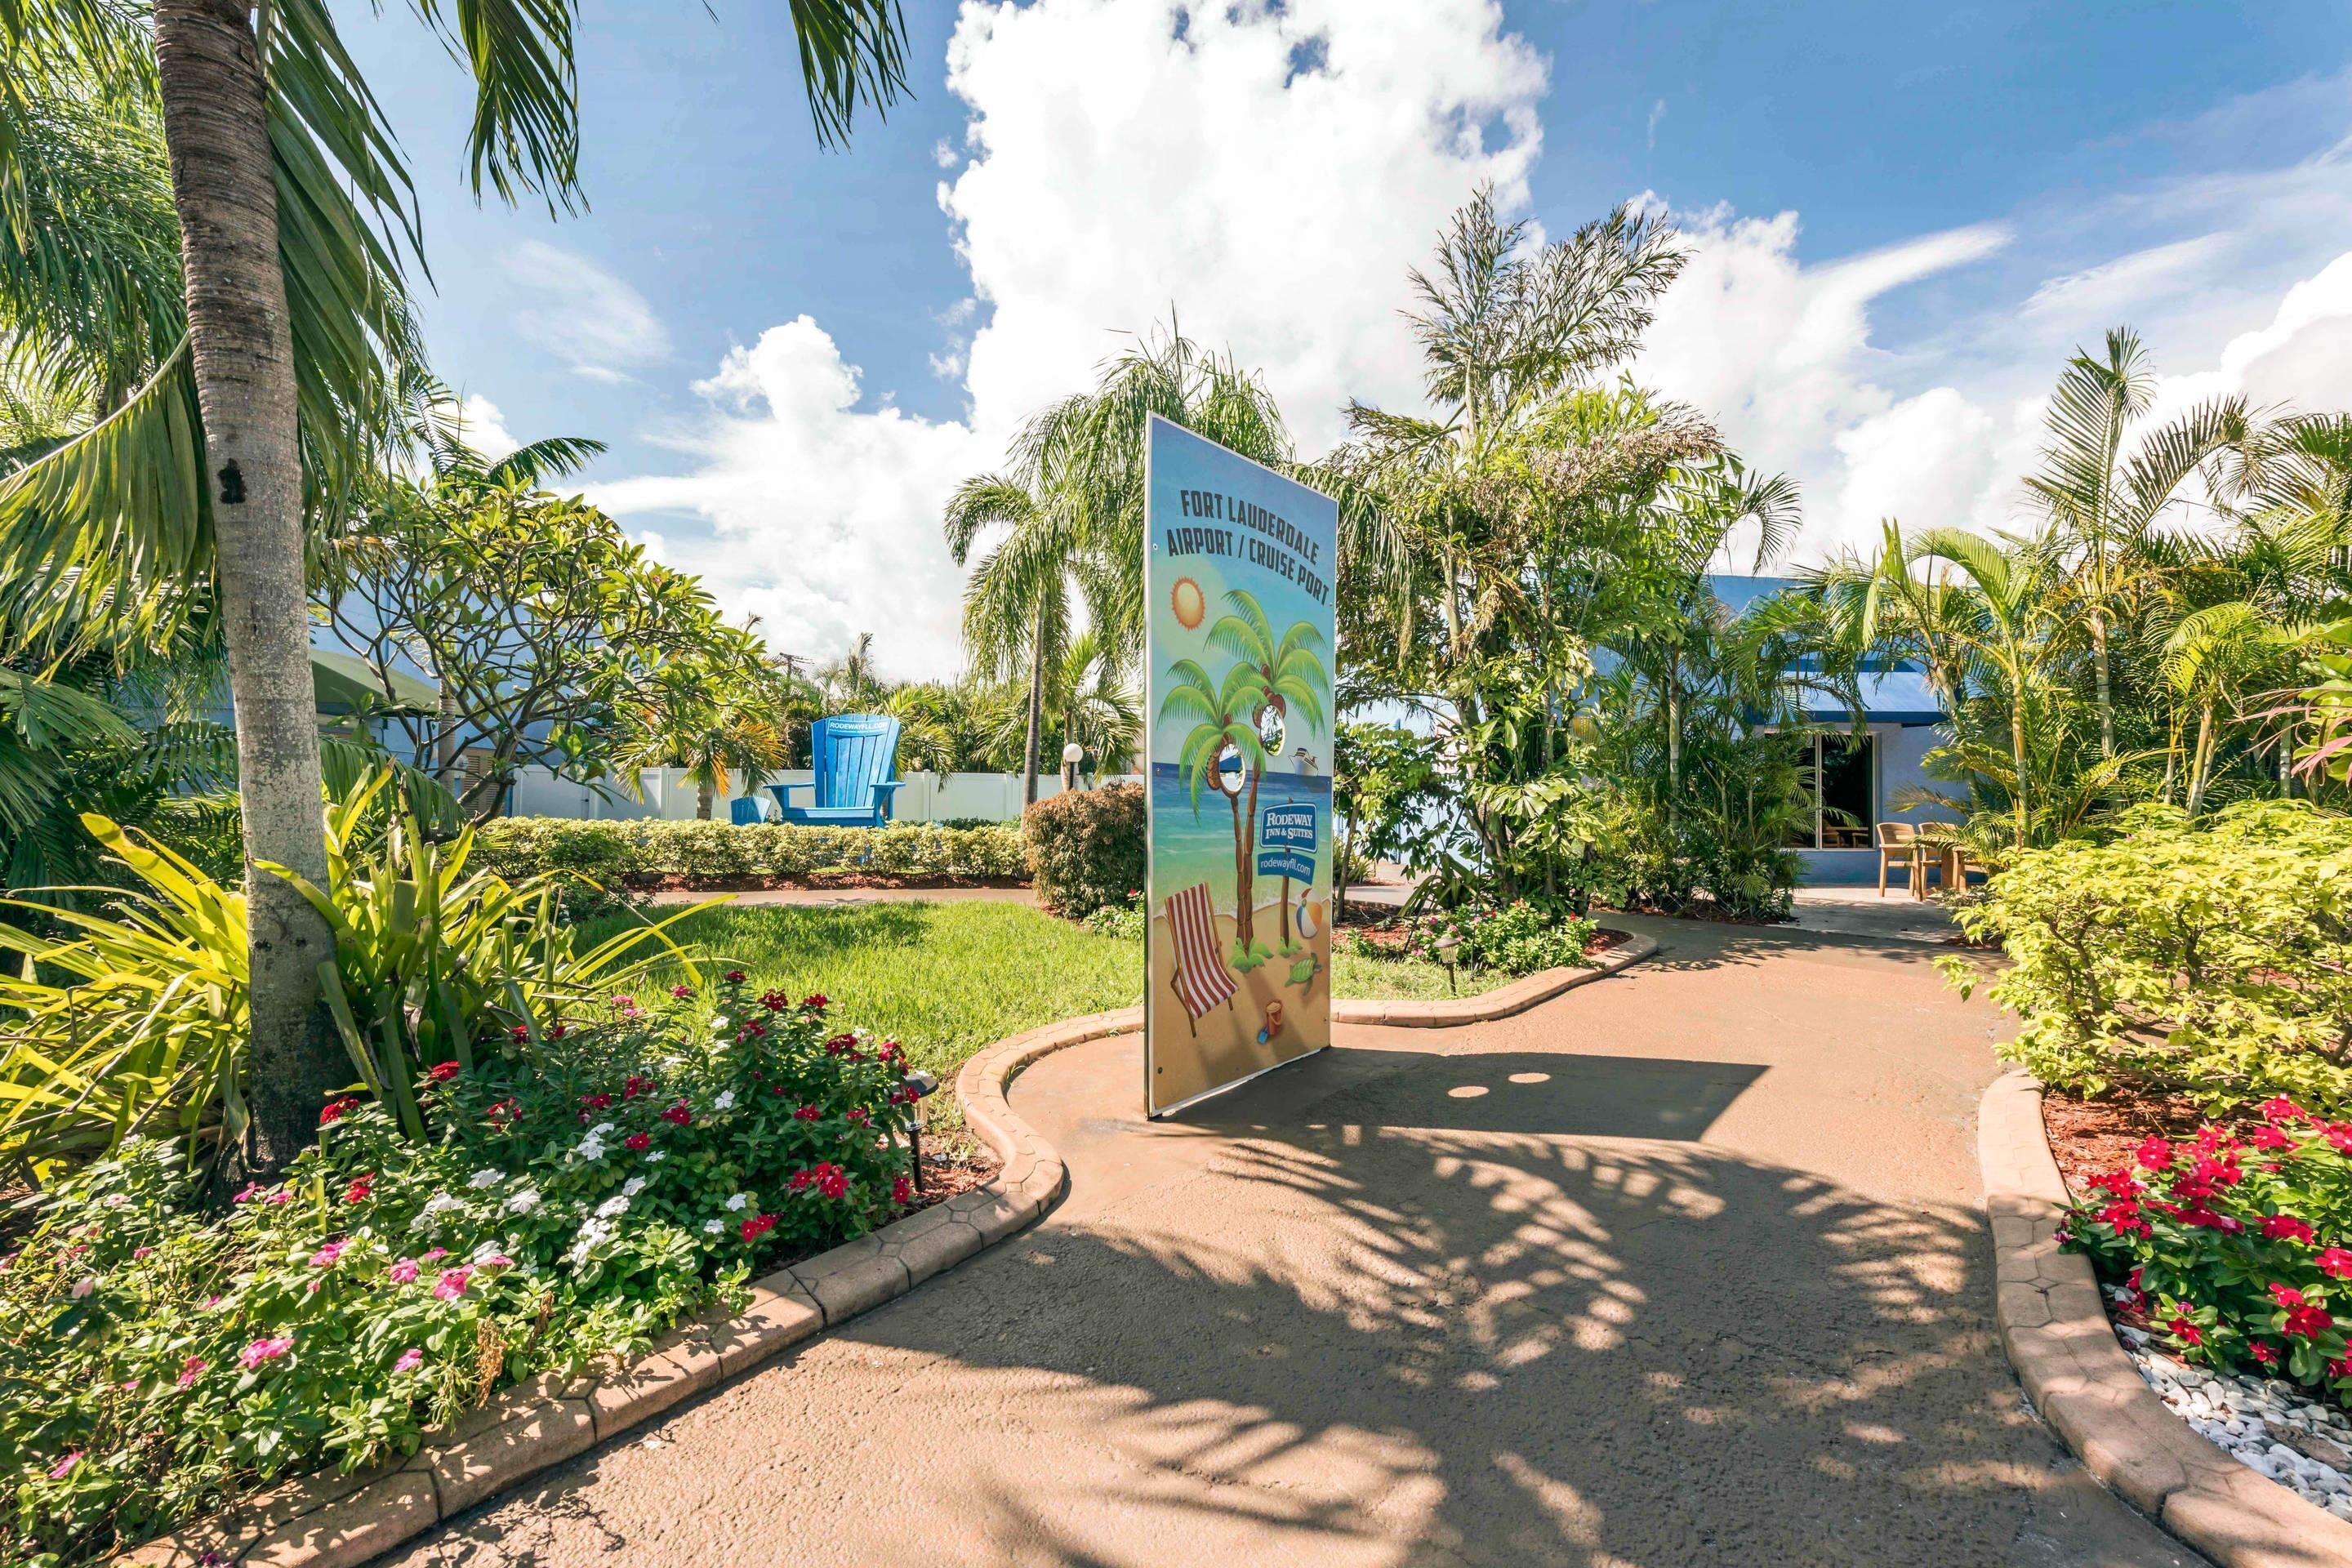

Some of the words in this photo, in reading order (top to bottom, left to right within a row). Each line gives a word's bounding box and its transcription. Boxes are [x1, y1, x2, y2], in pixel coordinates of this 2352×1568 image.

[1180, 490, 1223, 519] FORT
[1228, 496, 1320, 565] LAUDERDALE
[1166, 528, 1233, 557] AIRPORT
[1238, 535, 1245, 559] /
[1249, 537, 1295, 581] CRUISE
[1297, 564, 1330, 605] PORT
[1265, 828, 1281, 840] INN
[1288, 828, 1313, 840] SUITES
[1266, 813, 1313, 826] RODEWAY
